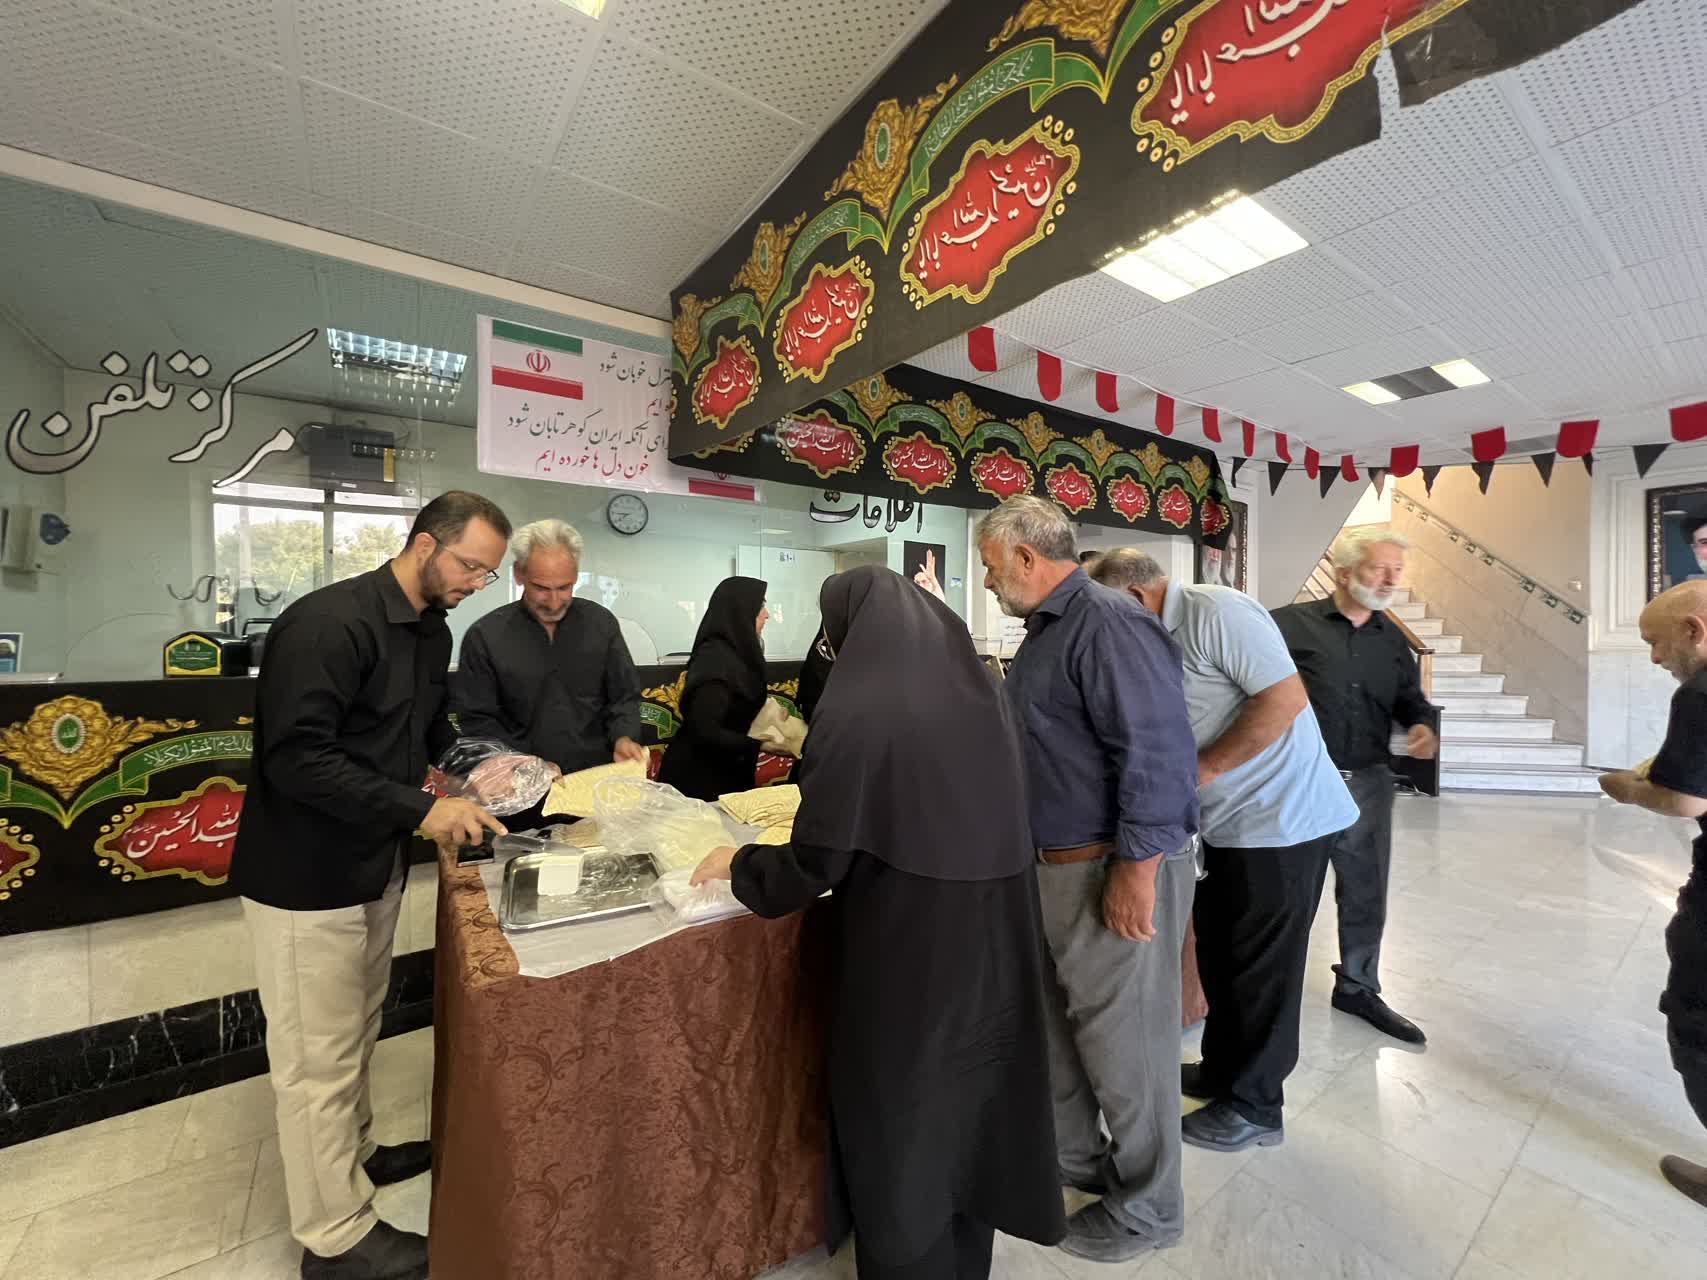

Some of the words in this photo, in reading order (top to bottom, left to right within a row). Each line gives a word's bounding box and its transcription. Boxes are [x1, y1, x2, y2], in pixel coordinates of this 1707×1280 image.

[599, 351, 618, 373] شود
[617, 360, 646, 383] خوبان
[648, 367, 672, 387] نزل
[6, 350, 211, 474] تلفن
[168, 328, 318, 488] مرکز
[507, 403, 529, 428] شود
[529, 411, 565, 439] تابان
[625, 421, 649, 445] آنکه
[588, 427, 622, 450] ایران
[535, 449, 556, 473] ایم
[559, 446, 590, 468] خورده
[602, 450, 622, 476] دل
[624, 454, 649, 479] خون
[808, 489, 923, 534] اطلاعات
